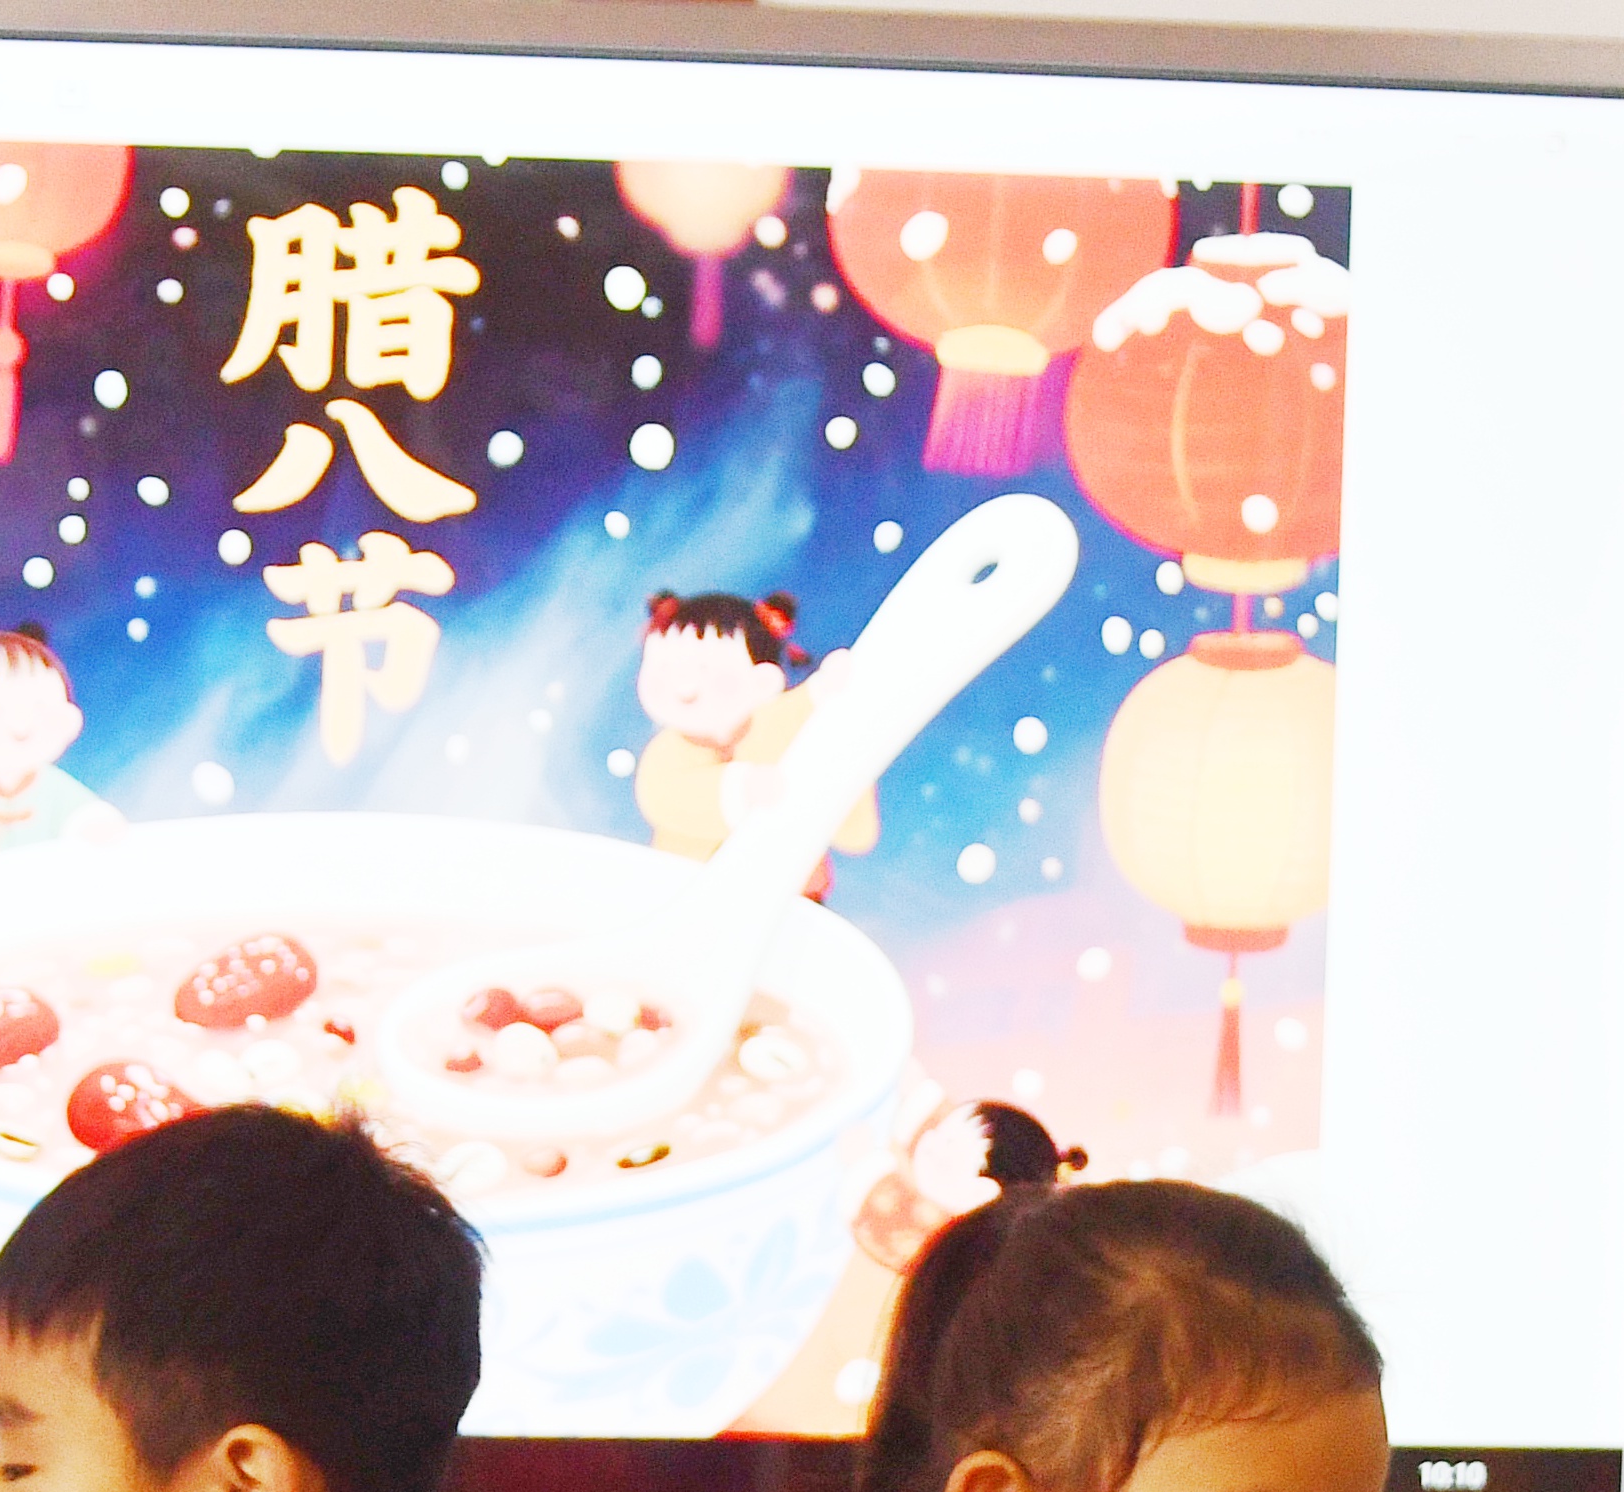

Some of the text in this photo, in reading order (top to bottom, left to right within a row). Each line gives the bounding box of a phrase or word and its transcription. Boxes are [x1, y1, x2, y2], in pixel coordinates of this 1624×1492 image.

[219, 185, 481, 767] 腊八节
[1418, 1460, 1488, 1491] 10:10
